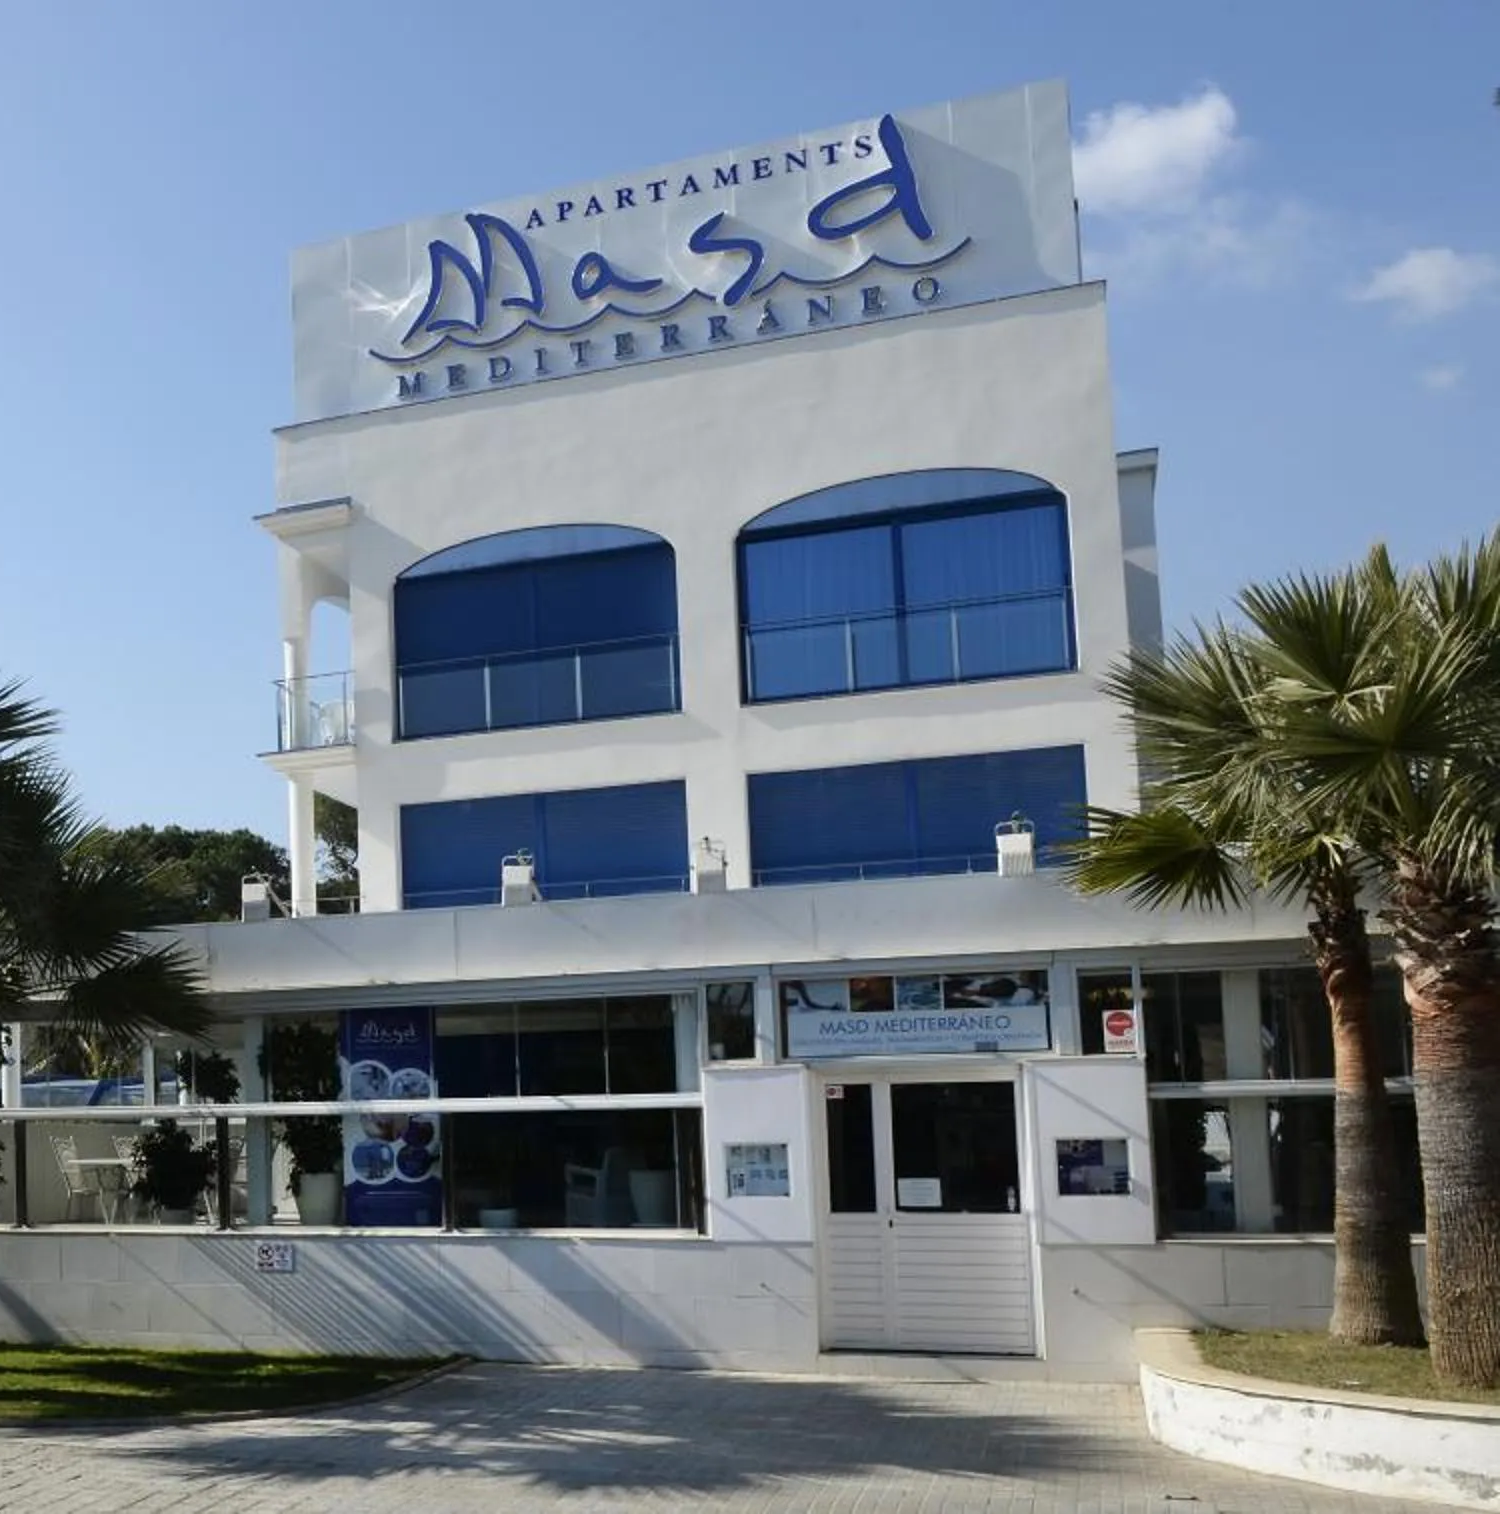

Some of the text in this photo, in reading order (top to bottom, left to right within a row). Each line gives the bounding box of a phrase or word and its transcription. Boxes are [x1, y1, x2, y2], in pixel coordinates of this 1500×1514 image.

[401, 113, 934, 345] Masd
[526, 134, 875, 230] APARTAMENTS
[396, 275, 944, 400] MEDITERRÁNEO
[819, 1011, 1012, 1036] MASD MEDITERRÁNEO
